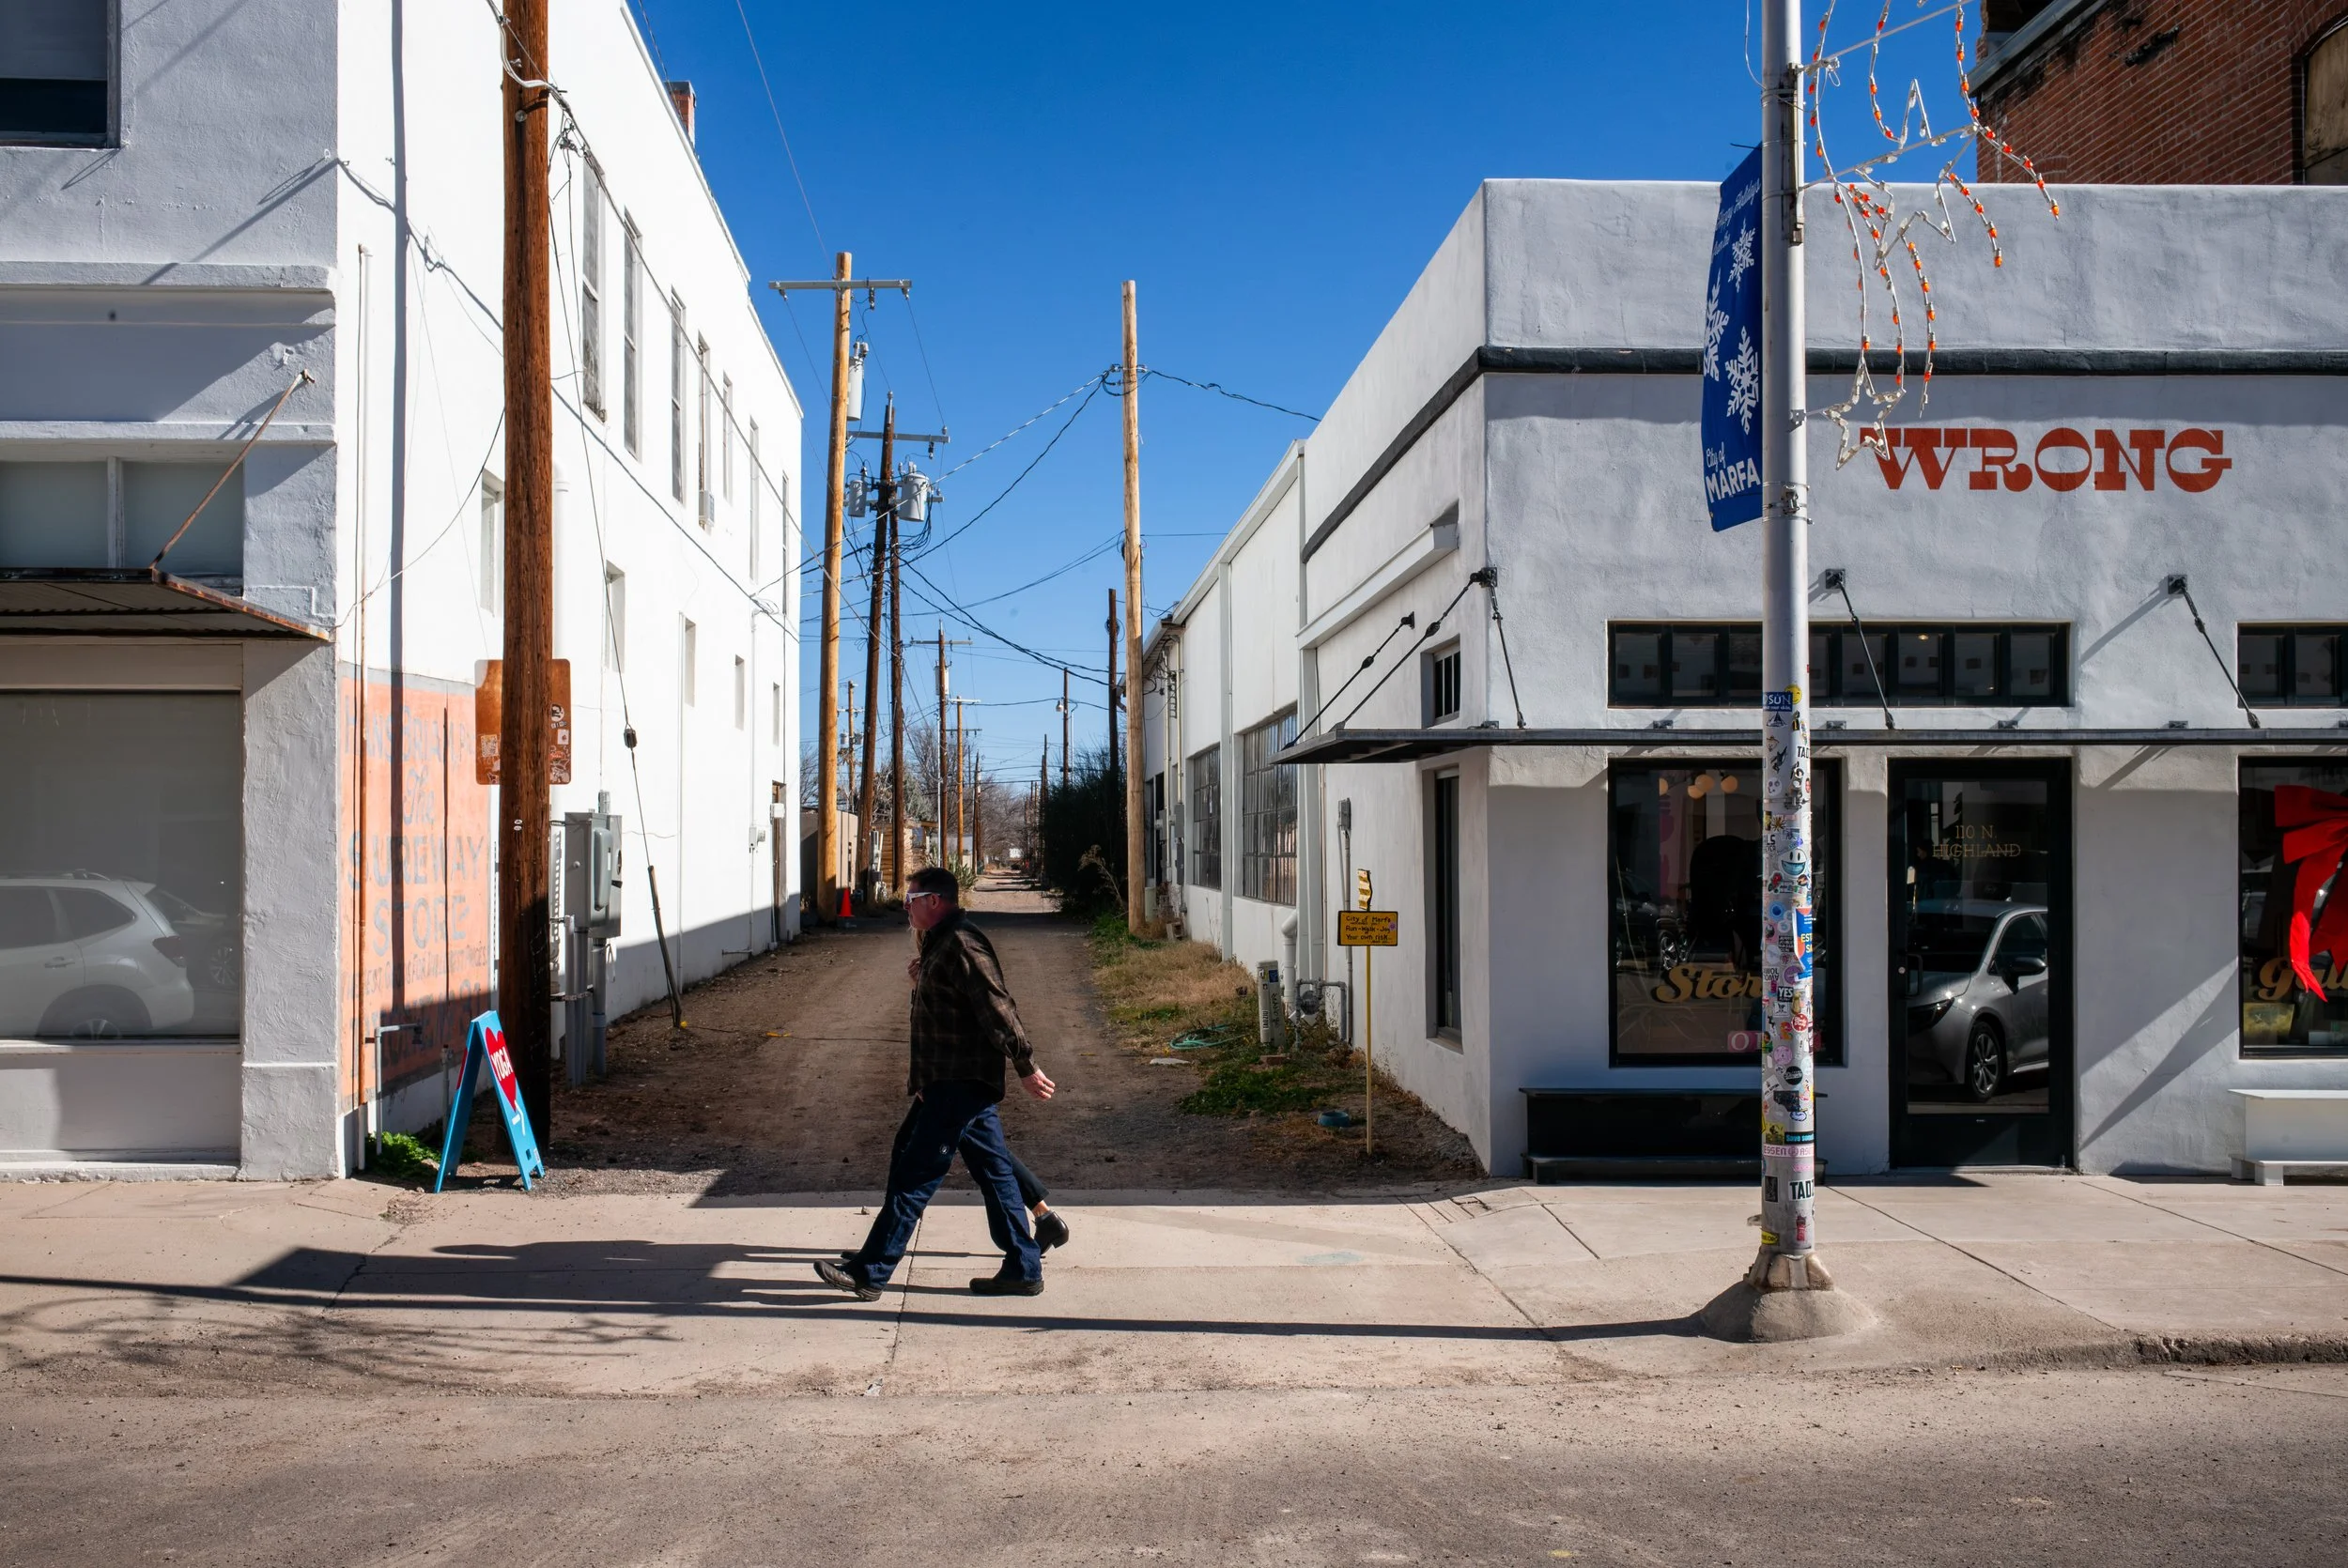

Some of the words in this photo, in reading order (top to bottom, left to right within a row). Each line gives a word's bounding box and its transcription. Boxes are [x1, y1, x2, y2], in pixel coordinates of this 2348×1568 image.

[1860, 426, 2232, 494] WRONG
[1706, 457, 1761, 503] MARFA
[1955, 825, 1975, 838] 110
[1982, 825, 1997, 838] N.
[1932, 844, 2021, 857] HIGHLAND
[1655, 962, 1763, 1003] Stor
[1779, 987, 1793, 997] YES
[490, 1046, 513, 1082] YOGA
